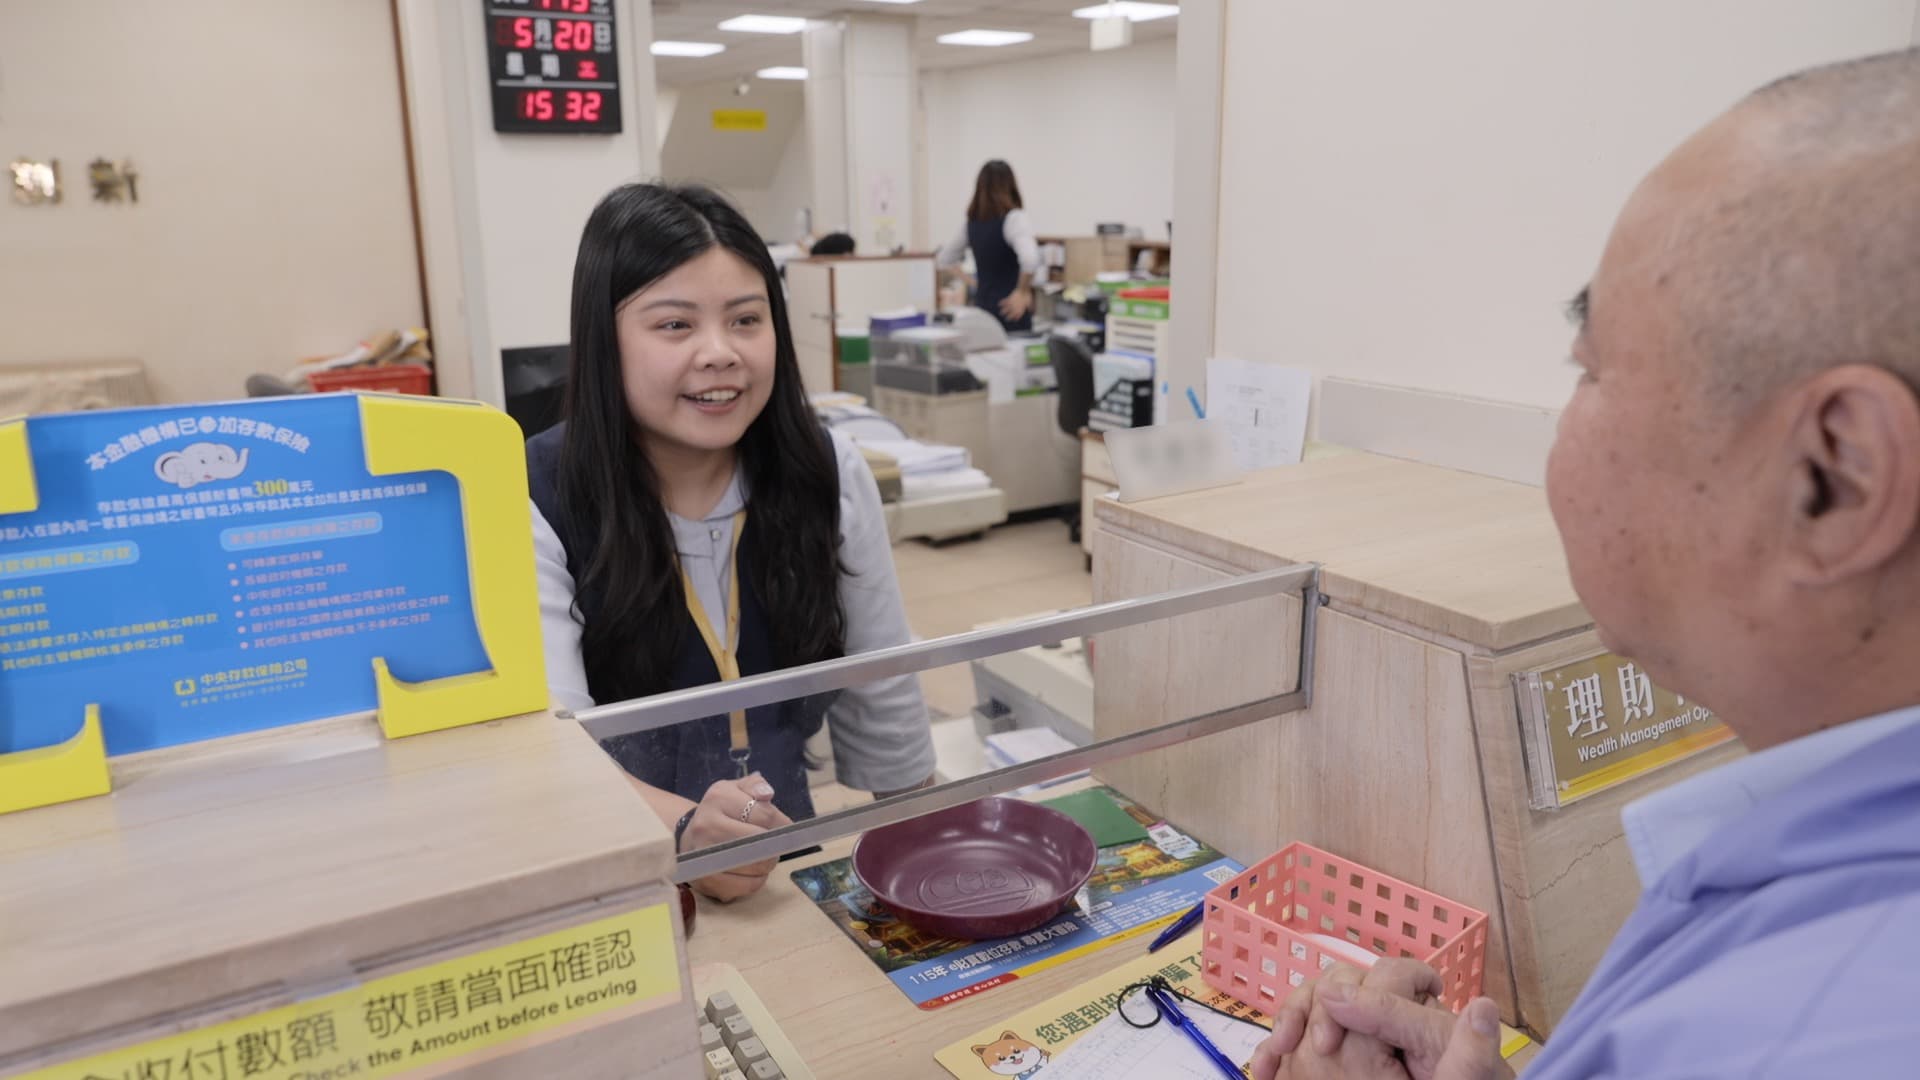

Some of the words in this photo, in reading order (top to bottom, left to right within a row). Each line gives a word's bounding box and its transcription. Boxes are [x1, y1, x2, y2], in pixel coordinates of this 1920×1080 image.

[525, 90, 553, 120] 15
[565, 91, 602, 121] 32
[1562, 662, 1684, 738] 理財
[1577, 737, 1619, 763] Wealth
[1620, 708, 1692, 748] Management
[82, 1011, 342, 1080] 收付數額
[364, 928, 637, 1040] 敬請當面確認
[909, 964, 949, 985] 115年
[367, 1049, 402, 1068] the
[410, 1021, 491, 1056] Amount
[496, 1001, 560, 1030] before
[565, 979, 638, 1010] Leaving
